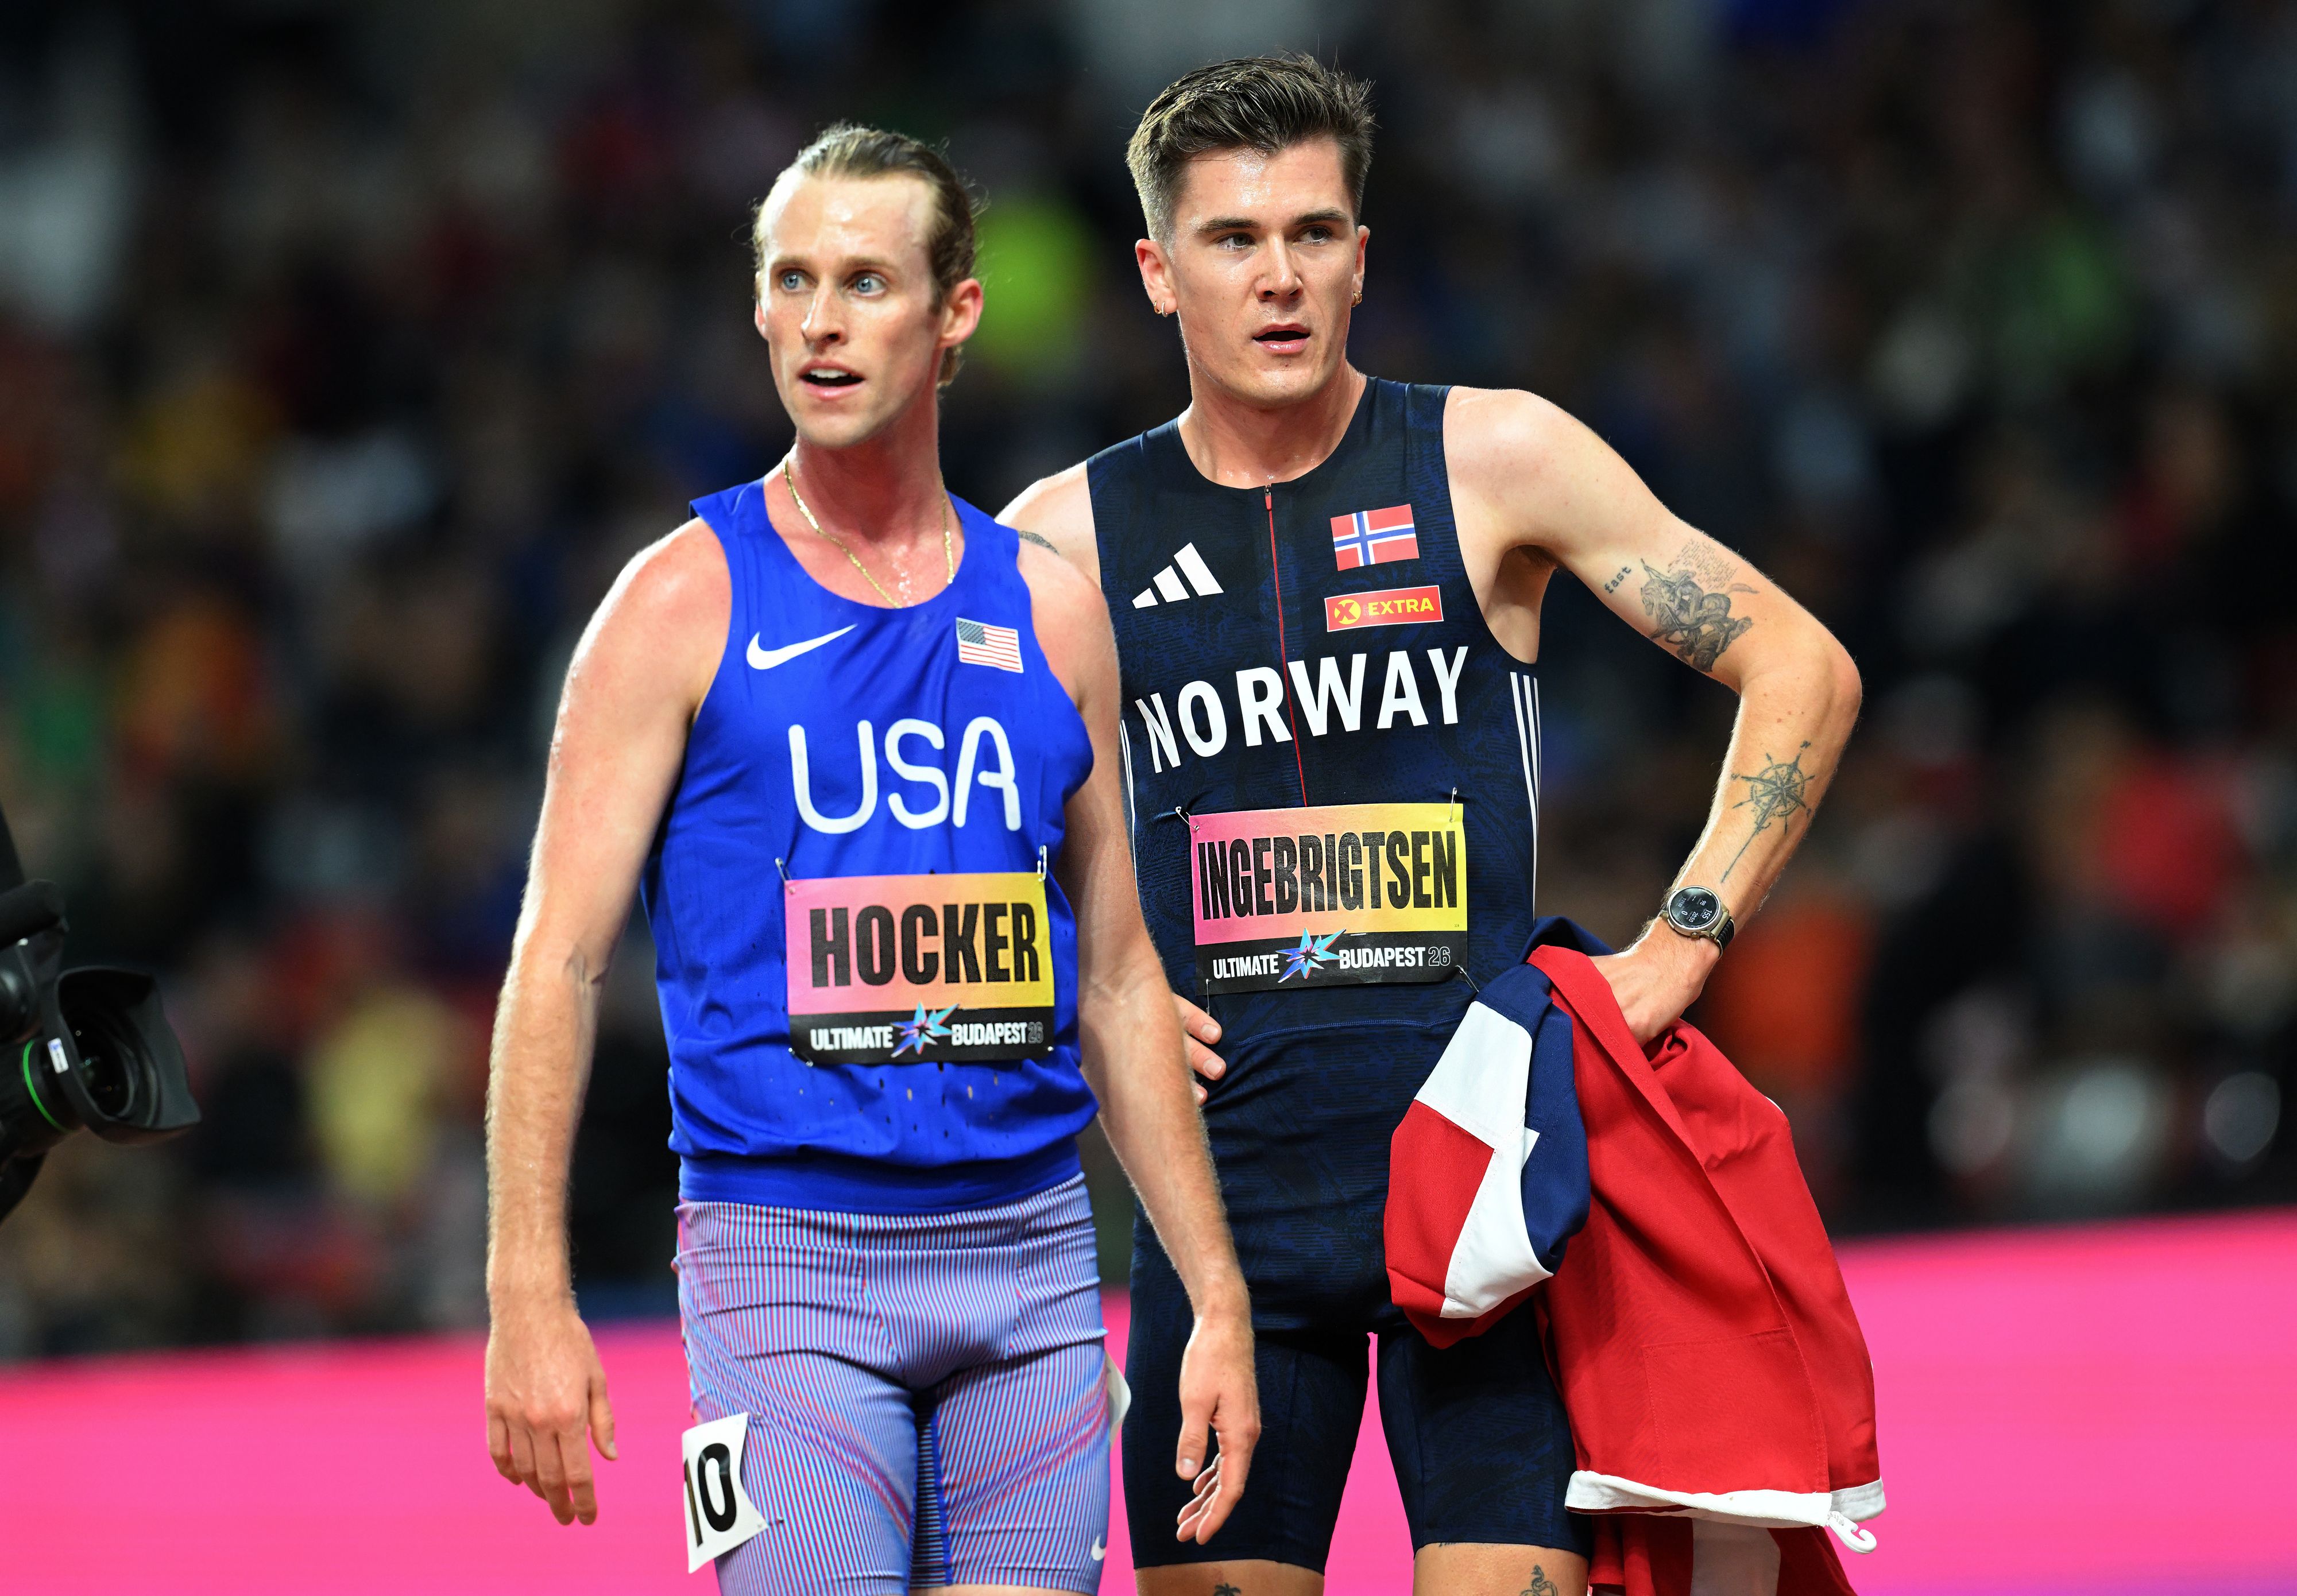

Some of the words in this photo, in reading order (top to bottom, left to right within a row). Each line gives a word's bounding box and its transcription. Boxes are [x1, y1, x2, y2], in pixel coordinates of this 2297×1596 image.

[1368, 598, 1434, 616] EXTRA
[1604, 567, 1631, 594] fast
[1135, 646, 1469, 773] NORWAY
[788, 716, 1021, 834] USA
[1198, 830, 1458, 920] INGEBRIGTSEN
[1702, 909, 1712, 920] 155
[809, 902, 1040, 988] HOCKER
[1213, 954, 1279, 979] ULTIMATE
[1339, 947, 1425, 969] BUDAPEST
[1428, 946, 1451, 967] 26
[810, 1025, 894, 1051] ULTIMATE
[951, 1022, 1027, 1046] BUDAPEST
[1027, 1021, 1044, 1044] 26
[684, 1443, 737, 1548] 10
